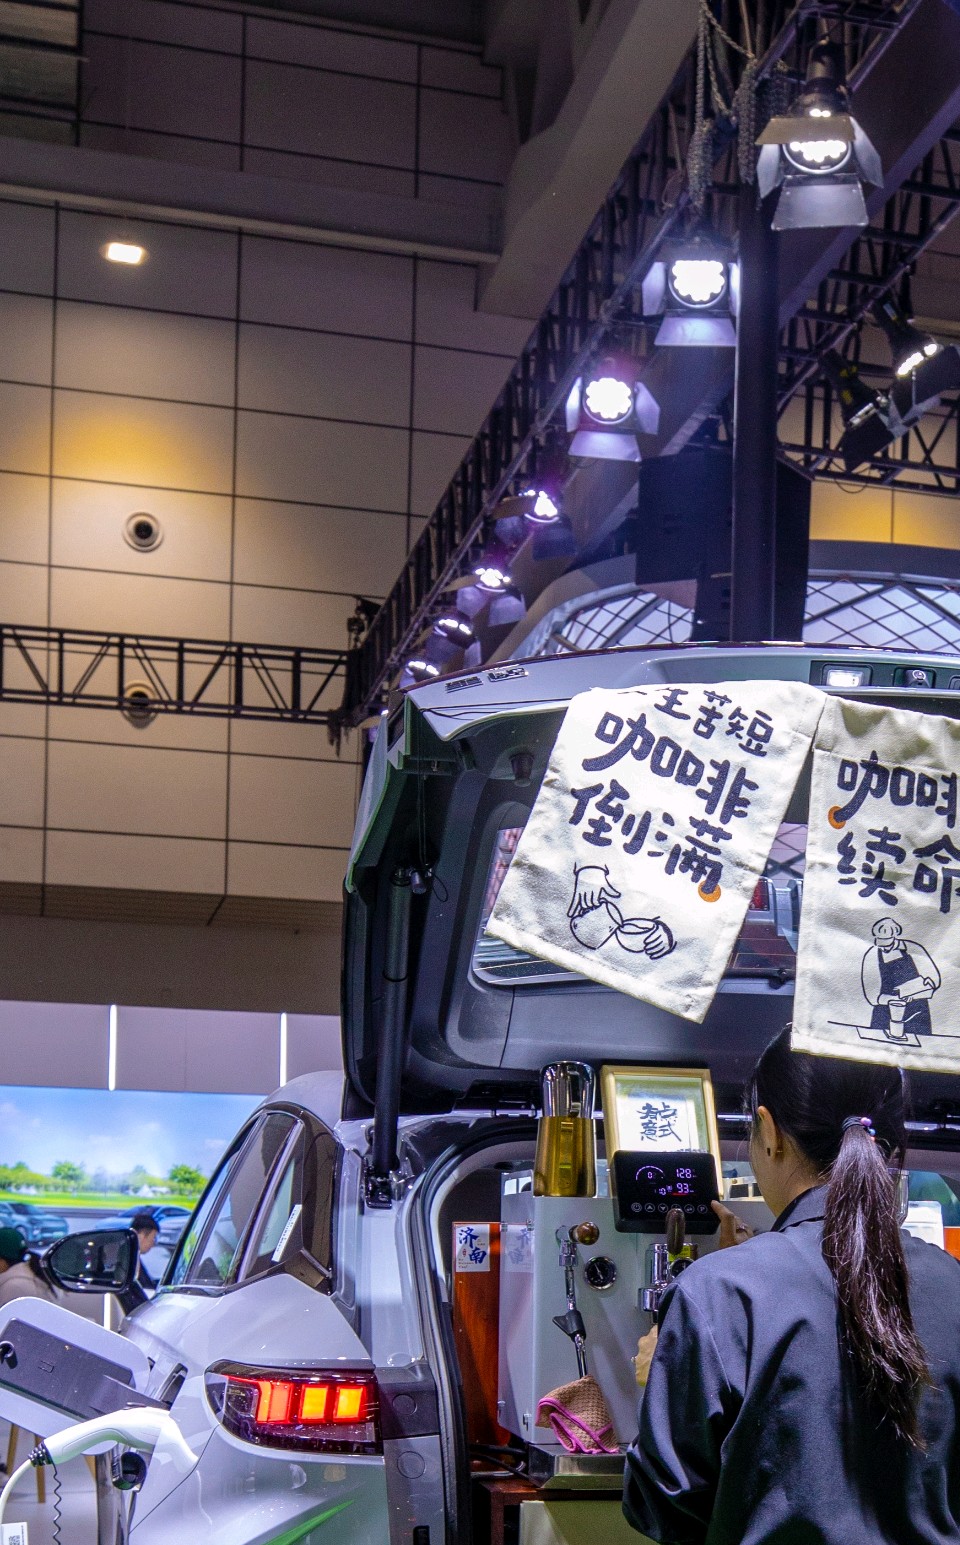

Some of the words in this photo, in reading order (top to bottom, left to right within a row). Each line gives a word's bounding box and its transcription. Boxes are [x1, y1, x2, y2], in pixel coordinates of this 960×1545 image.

[582, 712, 759, 825] 咖啡
[569, 779, 733, 894] 倒满
[676, 1168, 692, 1179] 128
[676, 1183, 689, 1194] 93
[458, 1226, 487, 1264] 济南
